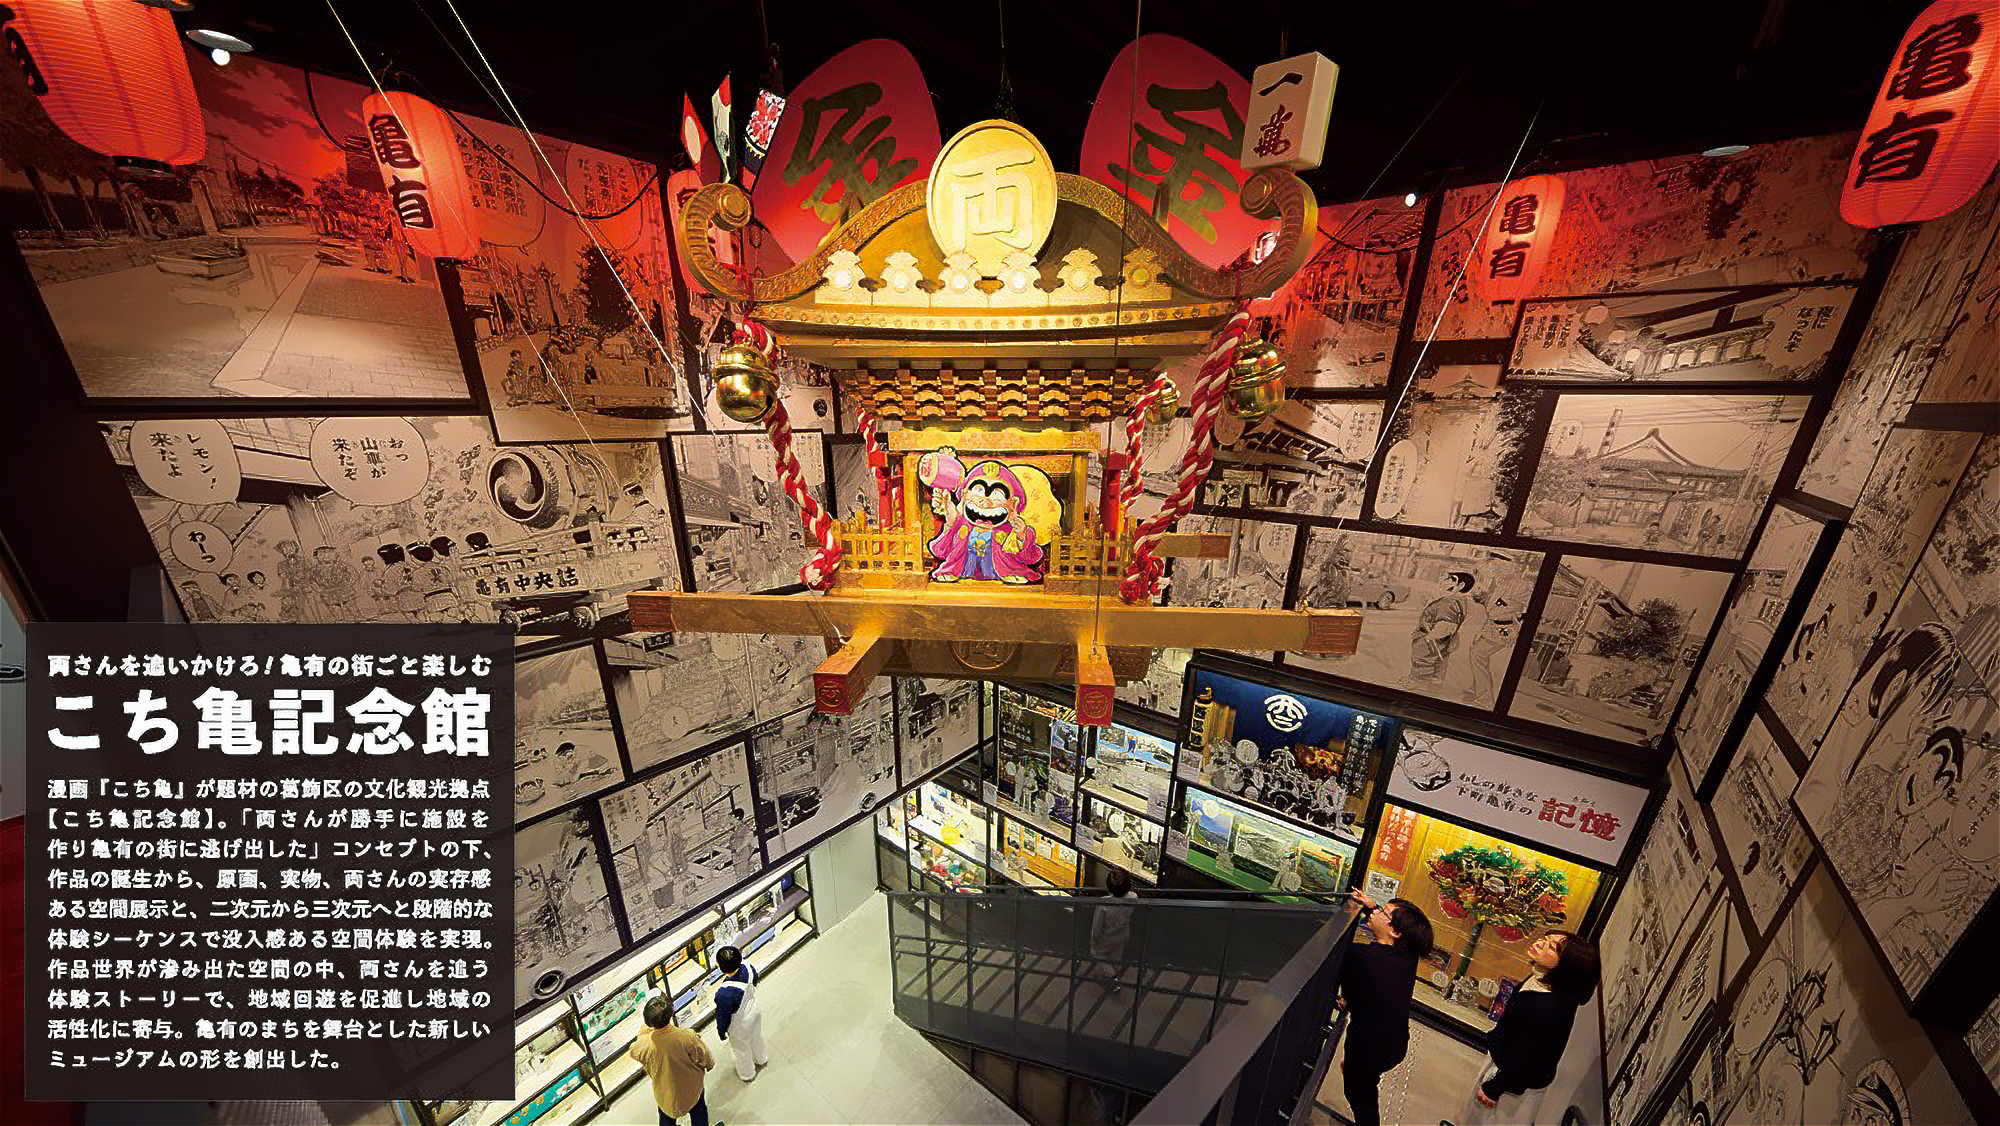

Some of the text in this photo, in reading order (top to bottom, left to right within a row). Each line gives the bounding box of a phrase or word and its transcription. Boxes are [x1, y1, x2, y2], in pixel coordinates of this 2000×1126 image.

[1253, 72, 1303, 158] 一萬
[1855, 13, 1983, 189] 亀有
[369, 114, 435, 228] 亀有
[947, 148, 1035, 252] 両
[1489, 193, 1539, 279] 亀有
[149, 432, 183, 478] 来たよ
[187, 433, 217, 490] レモン！
[332, 438, 358, 481] 来たぞ
[360, 436, 387, 479] 山車が
[388, 437, 408, 462] おっ
[1455, 784, 1533, 816] 下町亀有の
[1458, 772, 1539, 803] わしの好きな
[1537, 797, 1622, 842] 記憶
